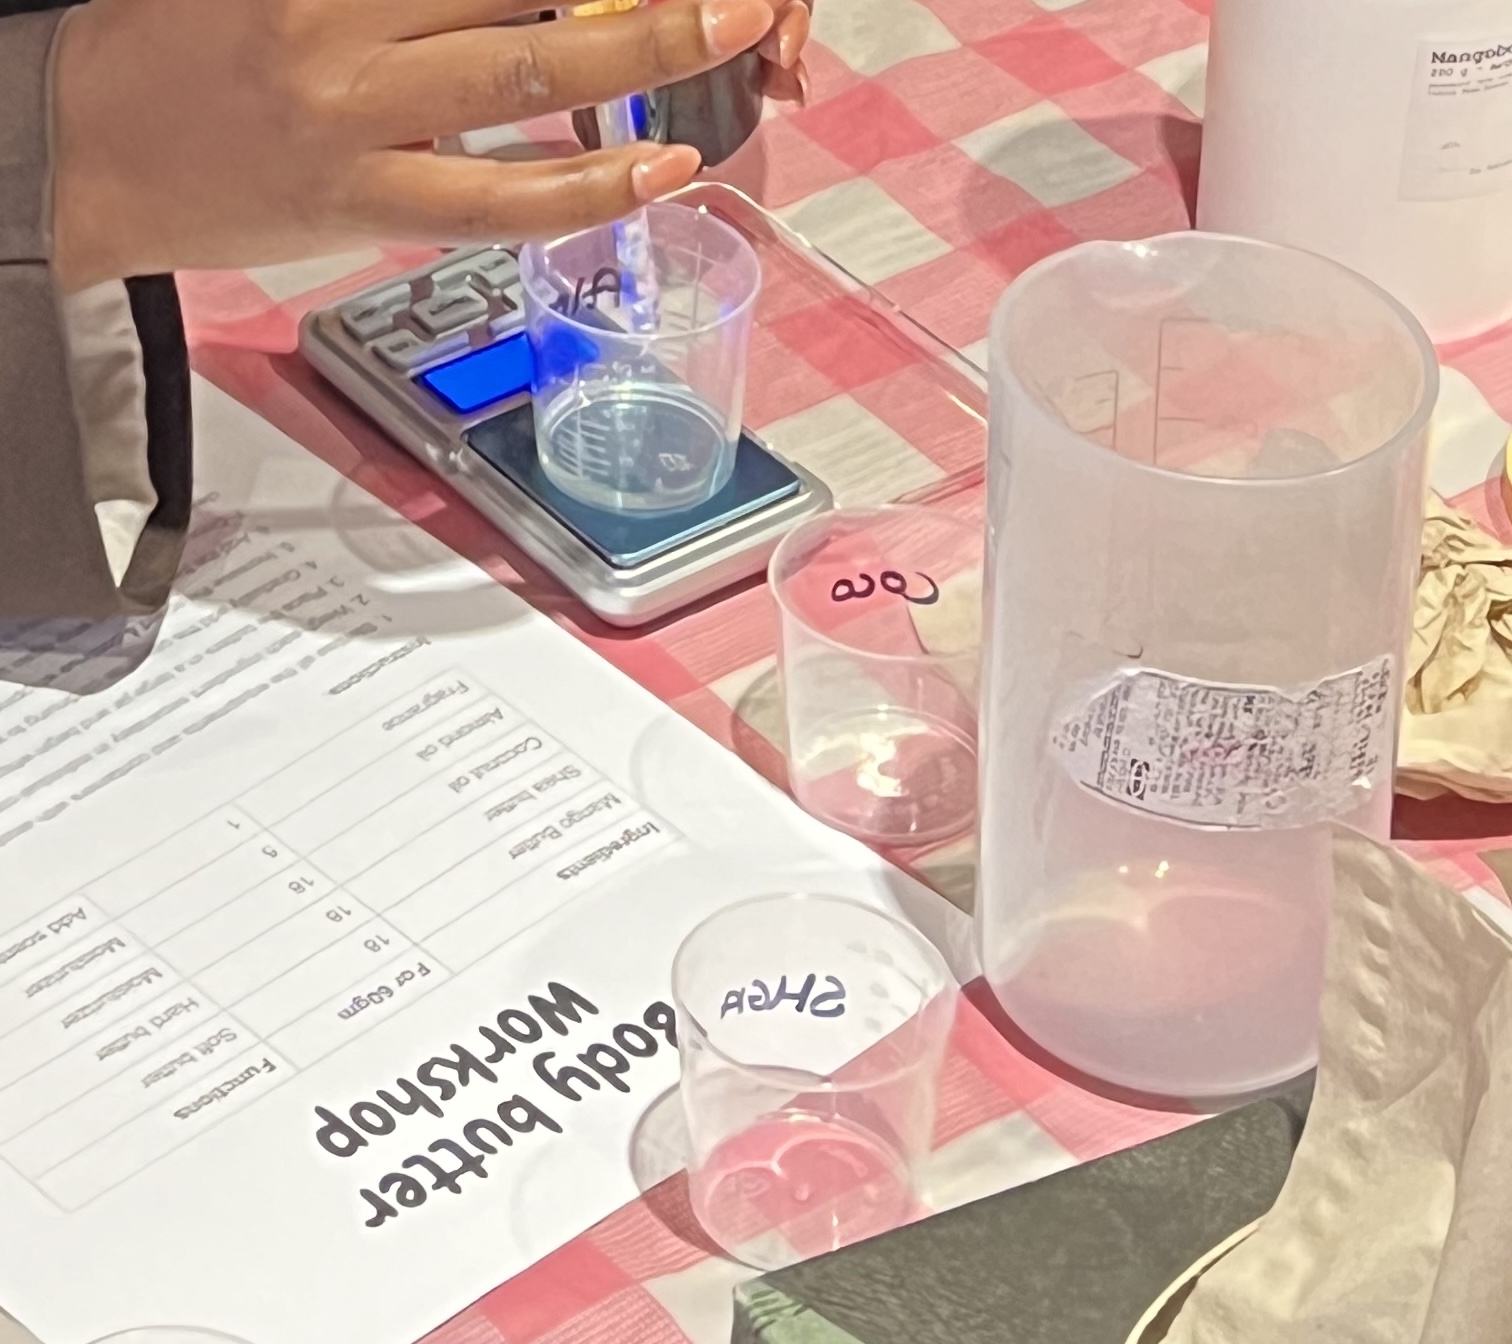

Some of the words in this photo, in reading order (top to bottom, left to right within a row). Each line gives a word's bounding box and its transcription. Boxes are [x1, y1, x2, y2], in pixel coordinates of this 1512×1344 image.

[530, 763, 583, 794] Shea
[557, 791, 623, 830] Mango
[555, 820, 662, 882] Ingredients
[287, 876, 315, 895] 18
[324, 905, 352, 924] 18
[362, 934, 391, 953] 18
[393, 961, 432, 989] For
[147, 996, 200, 1031] Hard
[336, 984, 395, 1021] 60gm
[191, 1027, 238, 1057] Soft
[140, 1051, 199, 1089] butter
[314, 981, 600, 1158] Workshop
[172, 1056, 278, 1121] Functions
[359, 1093, 564, 1228] butter
